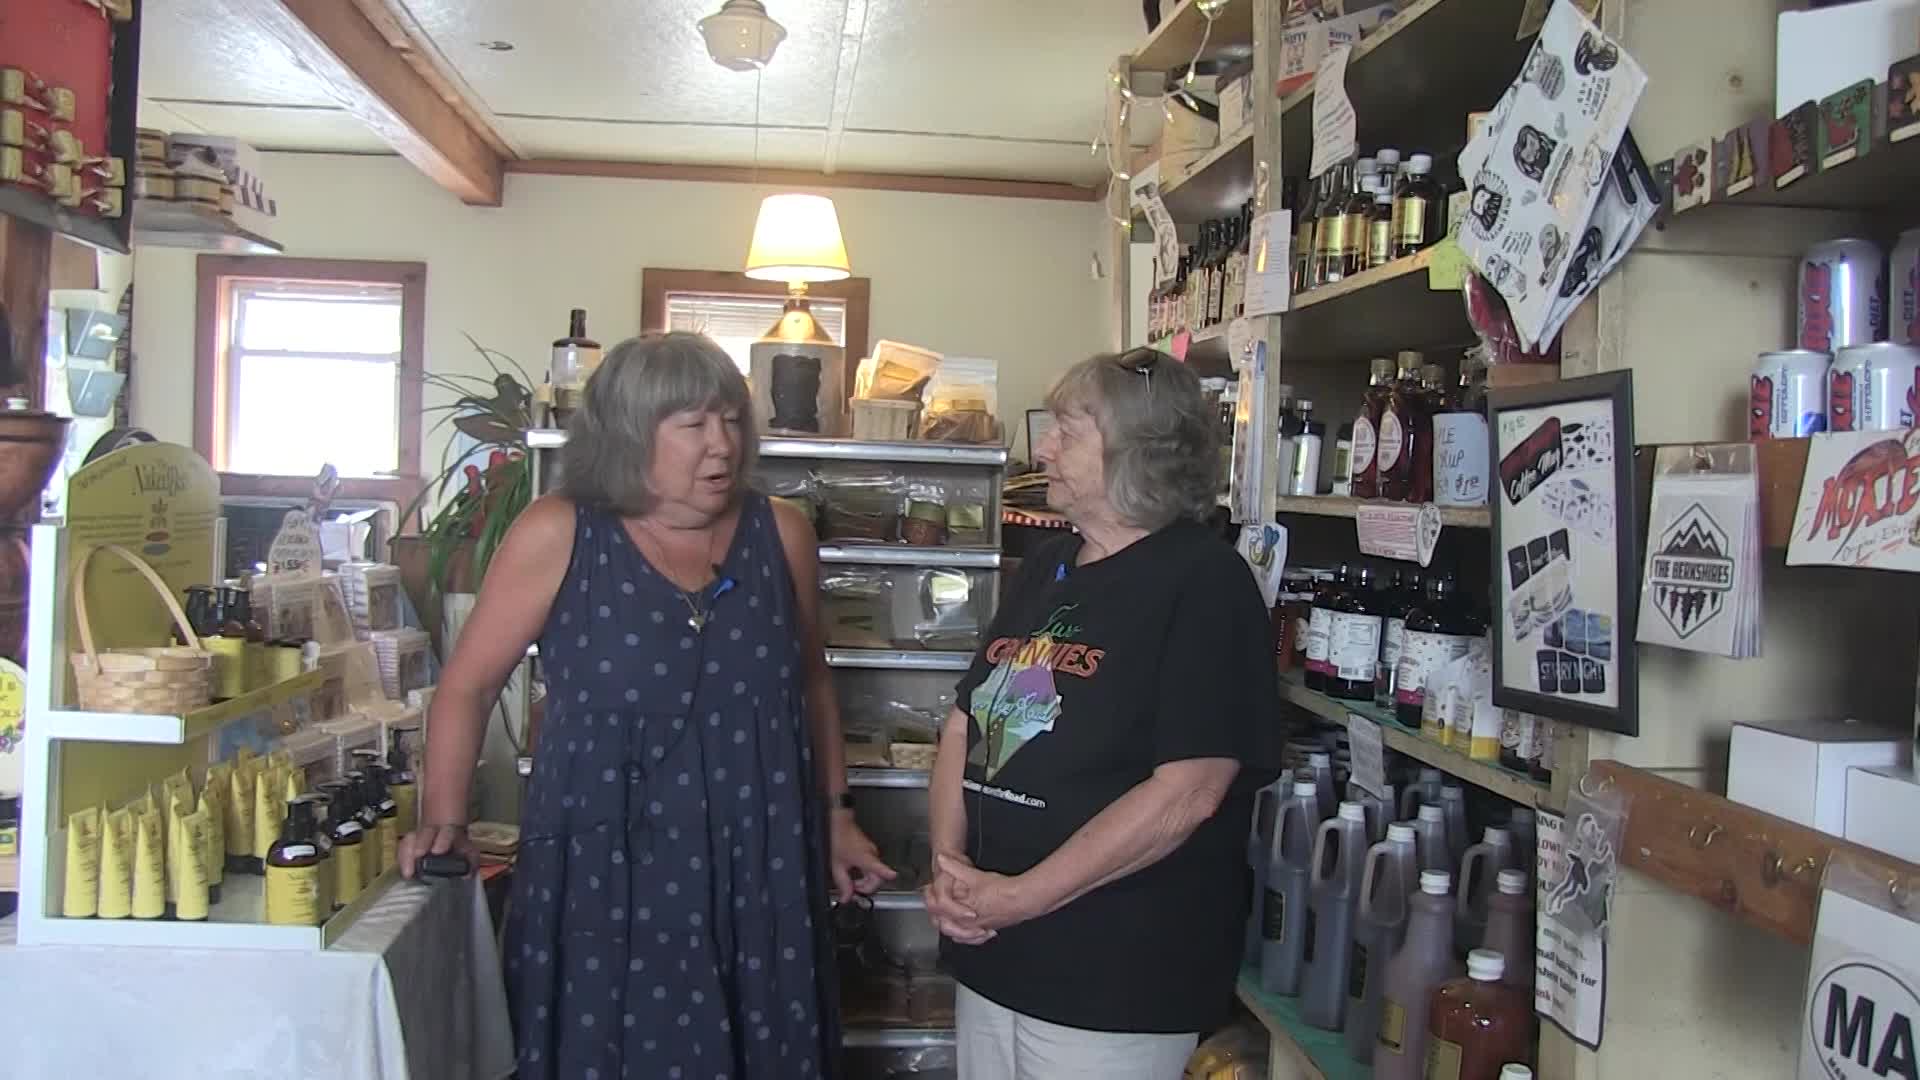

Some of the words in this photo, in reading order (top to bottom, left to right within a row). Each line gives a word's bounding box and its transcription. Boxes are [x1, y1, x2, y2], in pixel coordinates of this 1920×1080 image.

[1807, 454, 1920, 560] MOXIE
[1655, 560, 1670, 578] THE
[1671, 561, 1729, 584] BERKSHIRES
[1823, 982, 1920, 1080] MA
